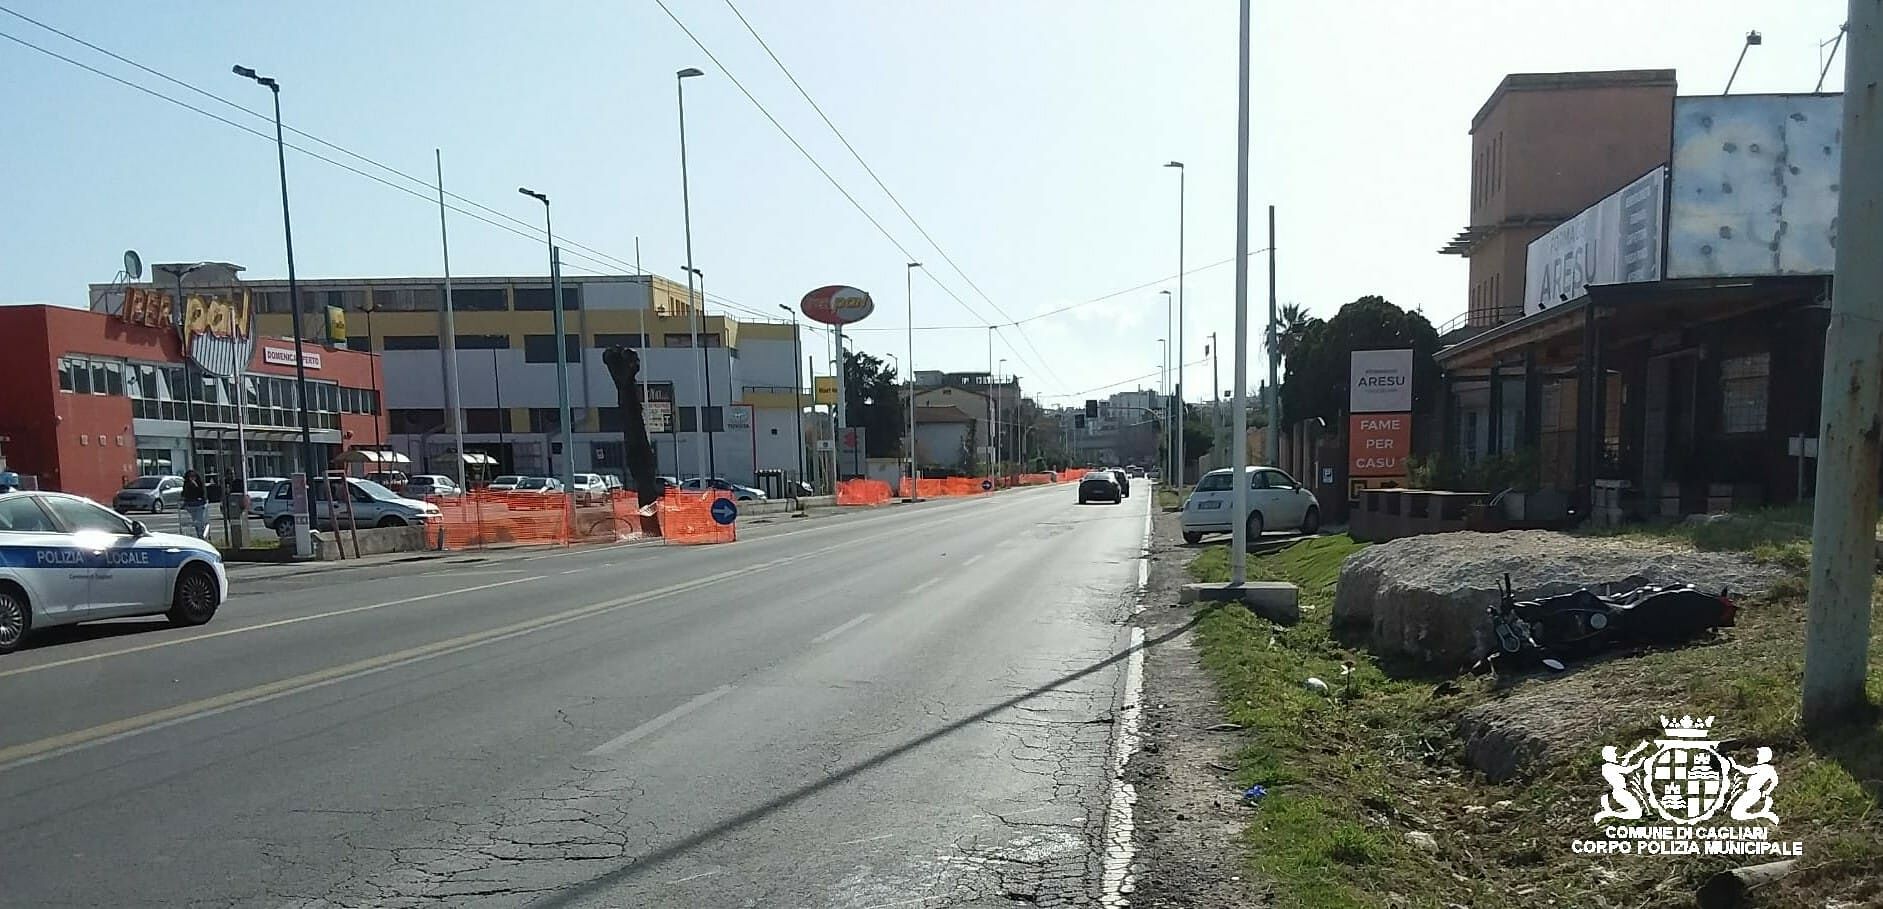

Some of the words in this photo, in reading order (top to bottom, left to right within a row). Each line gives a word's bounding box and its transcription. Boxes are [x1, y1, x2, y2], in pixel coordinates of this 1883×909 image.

[1540, 240, 1597, 303] ARESU
[1358, 375, 1405, 387] ARESU
[1360, 420, 1401, 431] FAME
[1366, 439, 1394, 449] PER
[1355, 457, 1396, 469] CASU
[37, 550, 85, 565] POLIZIA
[105, 551, 149, 565] LOCALE
